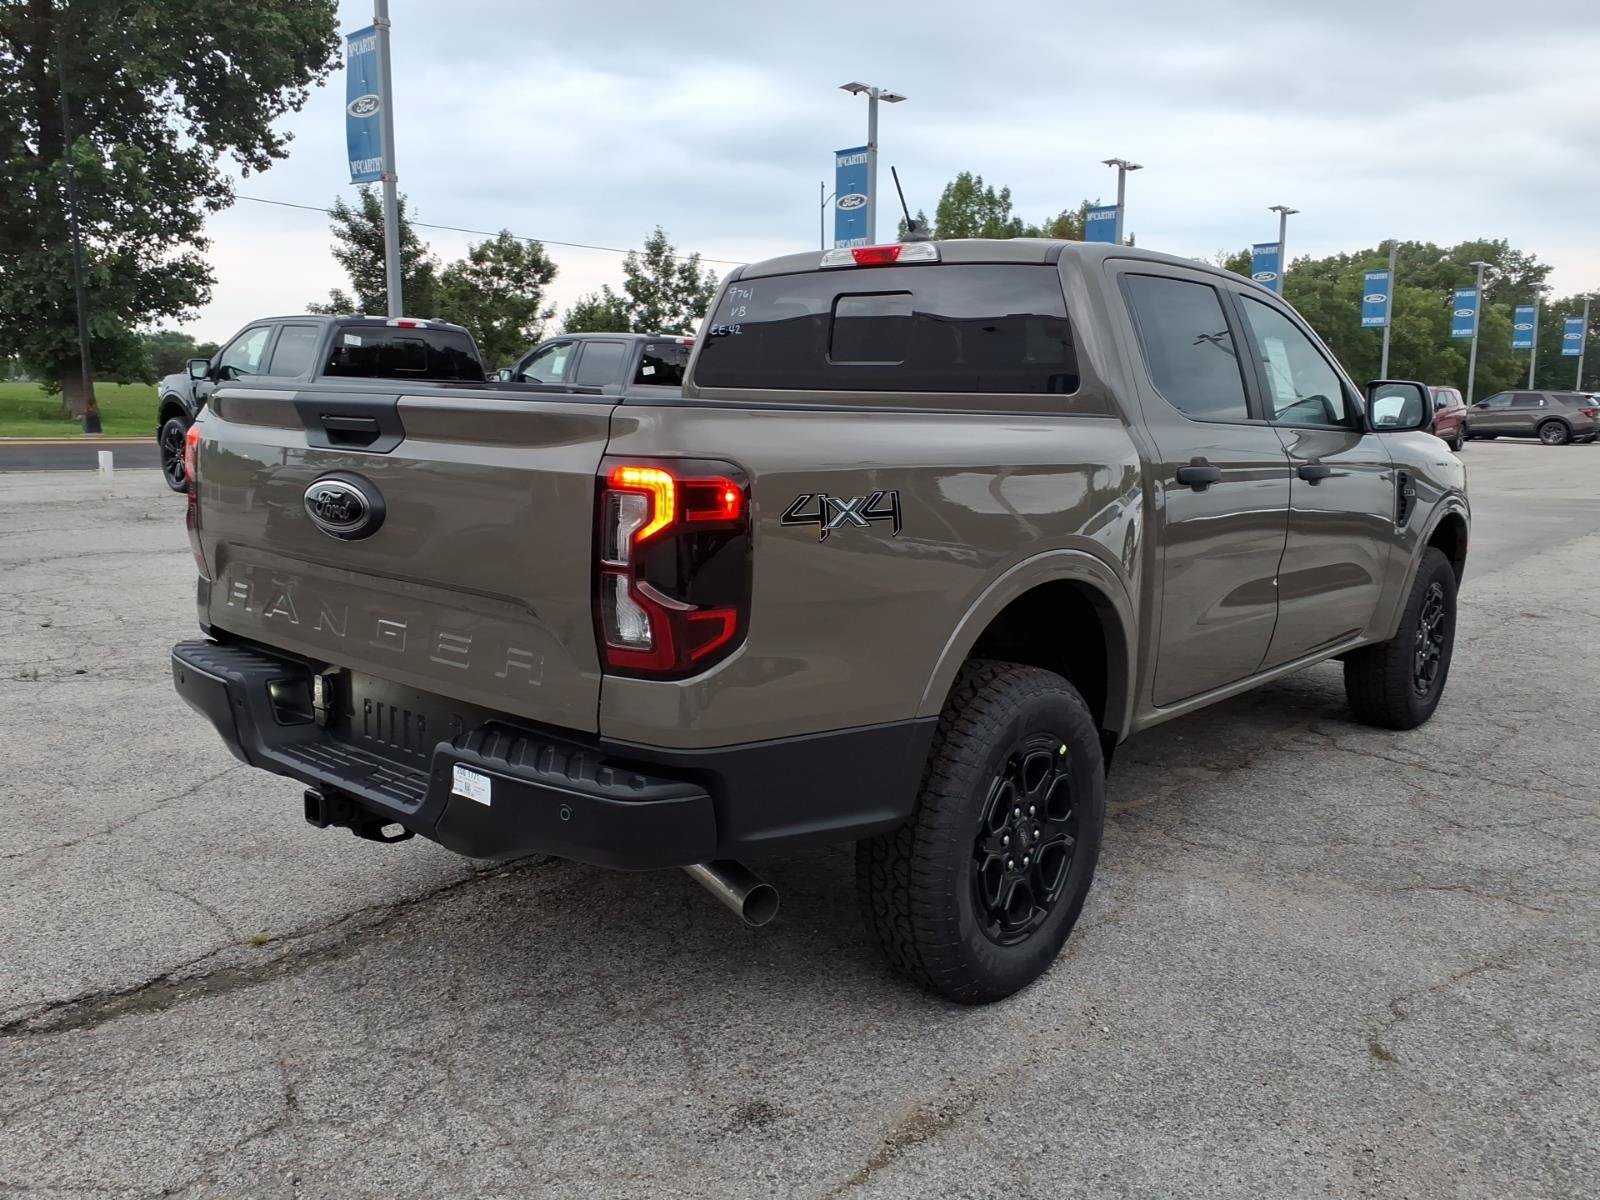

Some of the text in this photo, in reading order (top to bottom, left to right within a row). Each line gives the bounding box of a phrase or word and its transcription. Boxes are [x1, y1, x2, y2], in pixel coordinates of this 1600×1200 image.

[729, 286, 754, 302] 9761
[730, 306, 746, 317] VB
[315, 490, 351, 520] Ford
[226, 578, 546, 687] RANGER
